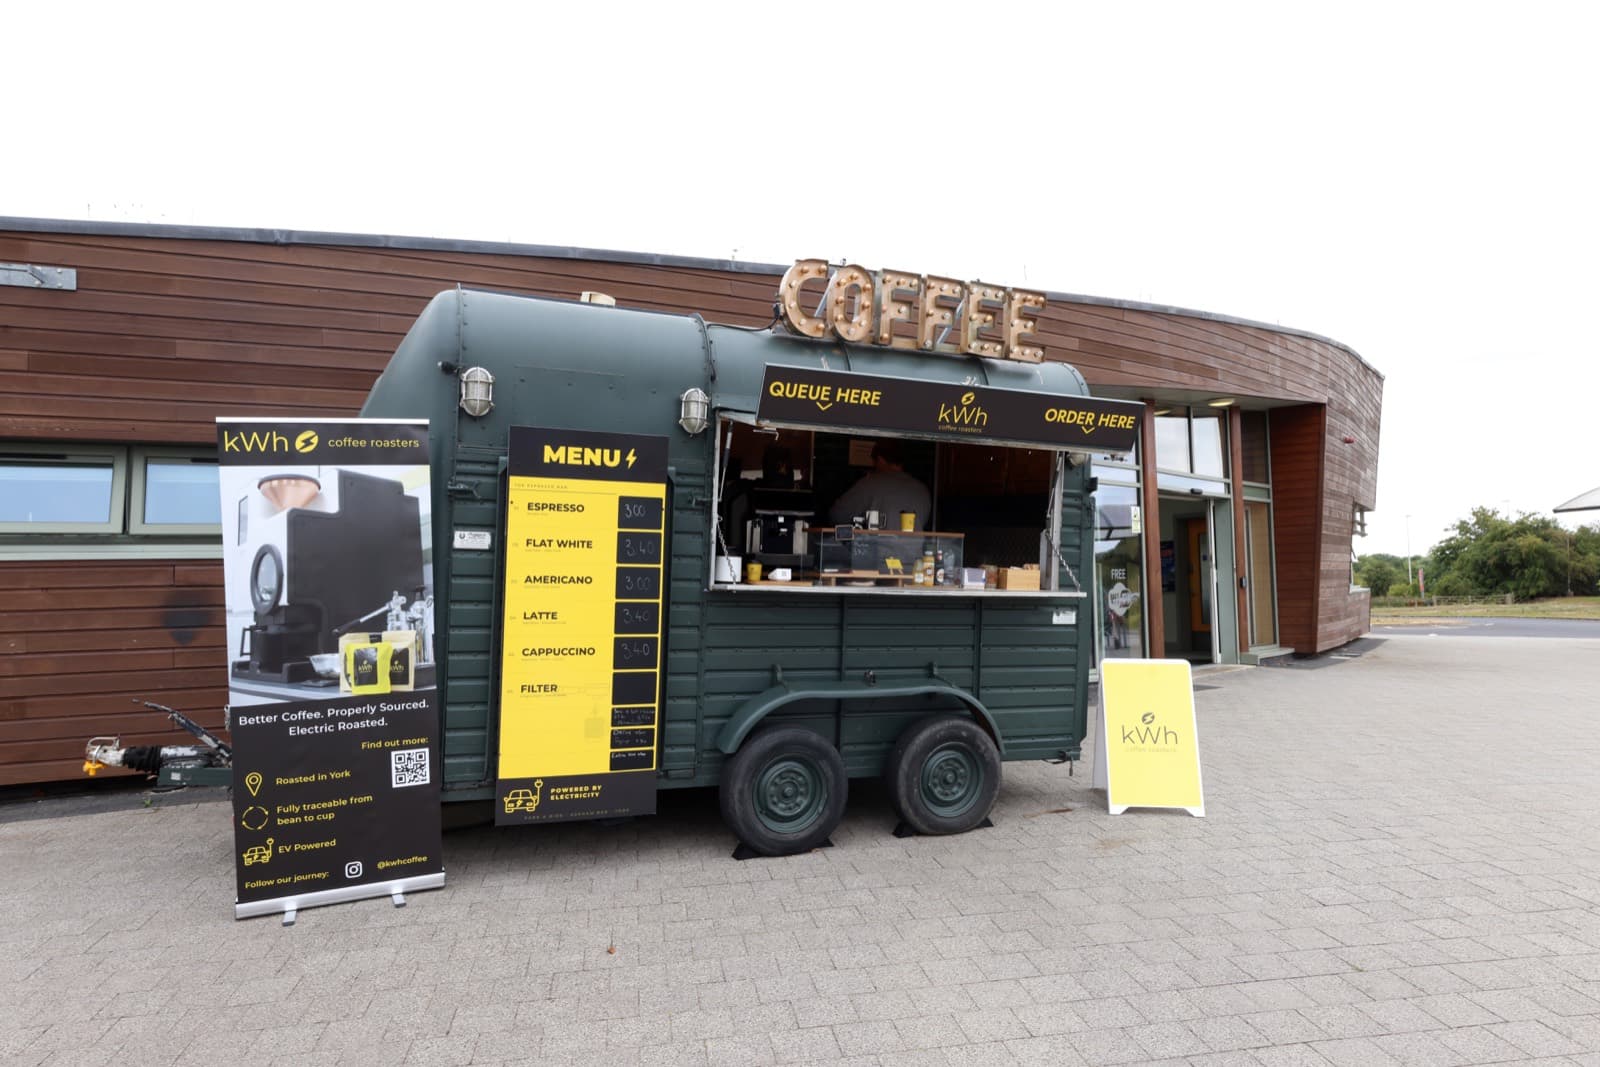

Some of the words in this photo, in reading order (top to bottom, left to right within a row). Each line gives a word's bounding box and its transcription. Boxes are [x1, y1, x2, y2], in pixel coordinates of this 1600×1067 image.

[779, 258, 1047, 363] COFFEE
[769, 381, 832, 400] QUEUE
[836, 387, 882, 406] HERE
[938, 403, 988, 426] kWh
[1044, 408, 1096, 426] ORDER
[1098, 413, 1136, 429] HERE
[224, 430, 289, 452] kWh
[328, 436, 367, 448] coffee
[370, 437, 420, 448] roasters
[543, 445, 621, 467] MENU
[527, 502, 585, 512] ESPRESSO
[526, 538, 554, 548] FLAT
[556, 539, 593, 549] WHITE
[524, 575, 593, 584] AMERICANO
[1111, 568, 1127, 580] FREE
[523, 611, 558, 620] LATTE
[522, 647, 596, 657] CAPPUCCINO
[520, 684, 558, 694] FILTER
[238, 713, 278, 726] Better
[282, 709, 324, 722] Coffee.
[327, 703, 377, 718] Properly
[380, 699, 430, 712] Sourced.
[288, 722, 334, 736] Electric
[338, 717, 388, 731] Roasted.
[1122, 724, 1178, 745] kWh
[361, 740, 382, 750] Find
[384, 739, 400, 748] out
[402, 737, 429, 746] more:
[276, 774, 316, 785] Roasted
[329, 769, 352, 780] York
[550, 786, 590, 794] POWERED
[550, 792, 600, 801] ELECTRICITY
[276, 804, 300, 814] Fully
[302, 798, 348, 811] traceable
[350, 795, 373, 804] from
[277, 816, 302, 826] bean
[304, 814, 314, 822] to
[316, 812, 336, 821] cup
[278, 844, 292, 854] EV
[294, 838, 337, 852] Powered
[376, 855, 428, 870] @kwhcoffee
[244, 879, 275, 889] Follow
[277, 876, 292, 884] our
[294, 871, 330, 884] journey:
